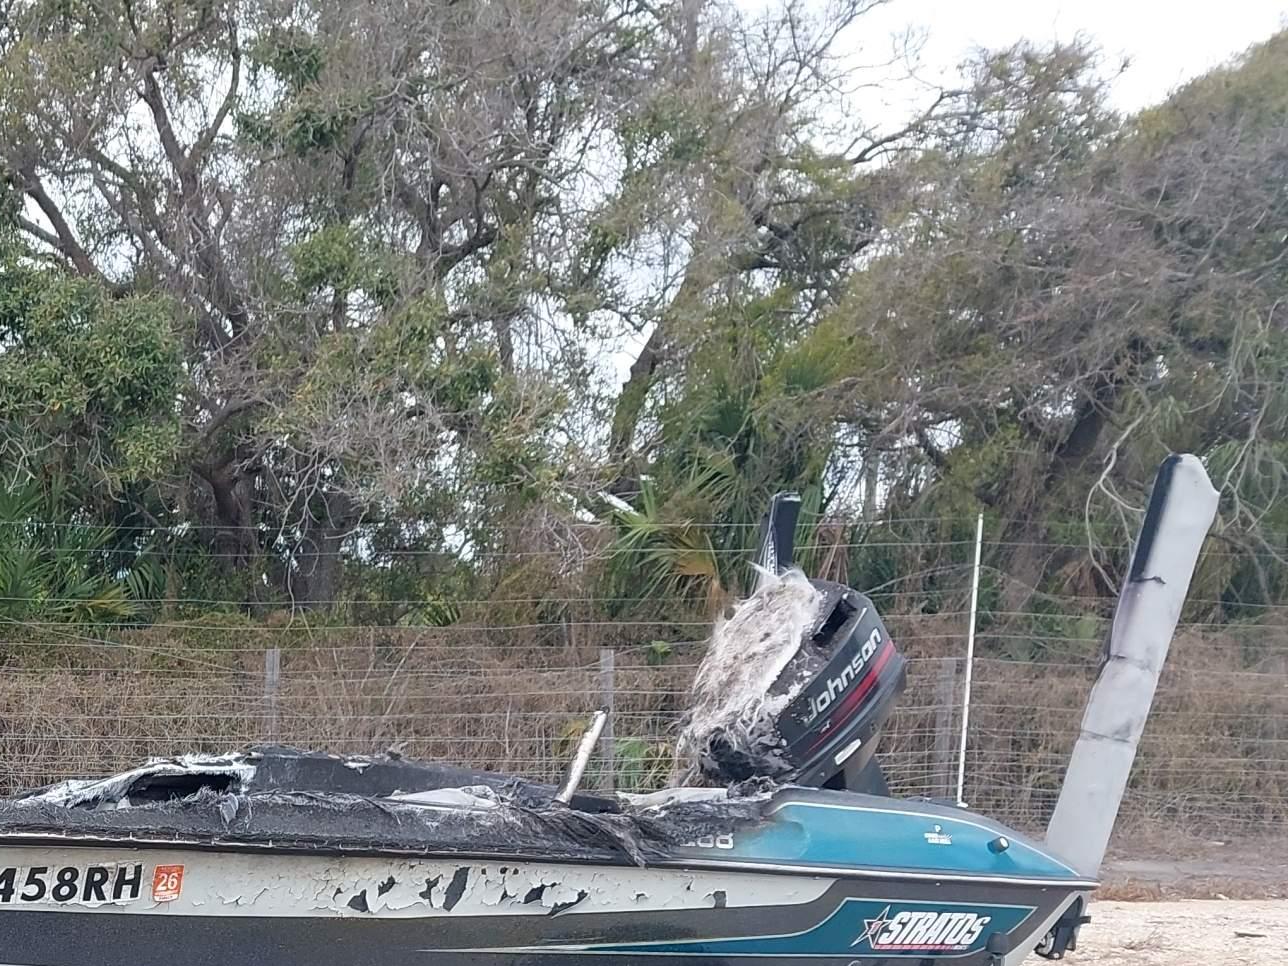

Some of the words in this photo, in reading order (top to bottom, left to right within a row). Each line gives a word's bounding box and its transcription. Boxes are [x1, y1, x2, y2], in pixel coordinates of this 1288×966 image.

[803, 627, 882, 726] Johnson
[155, 871, 179, 891] 26
[877, 911, 992, 945] STRATOS
